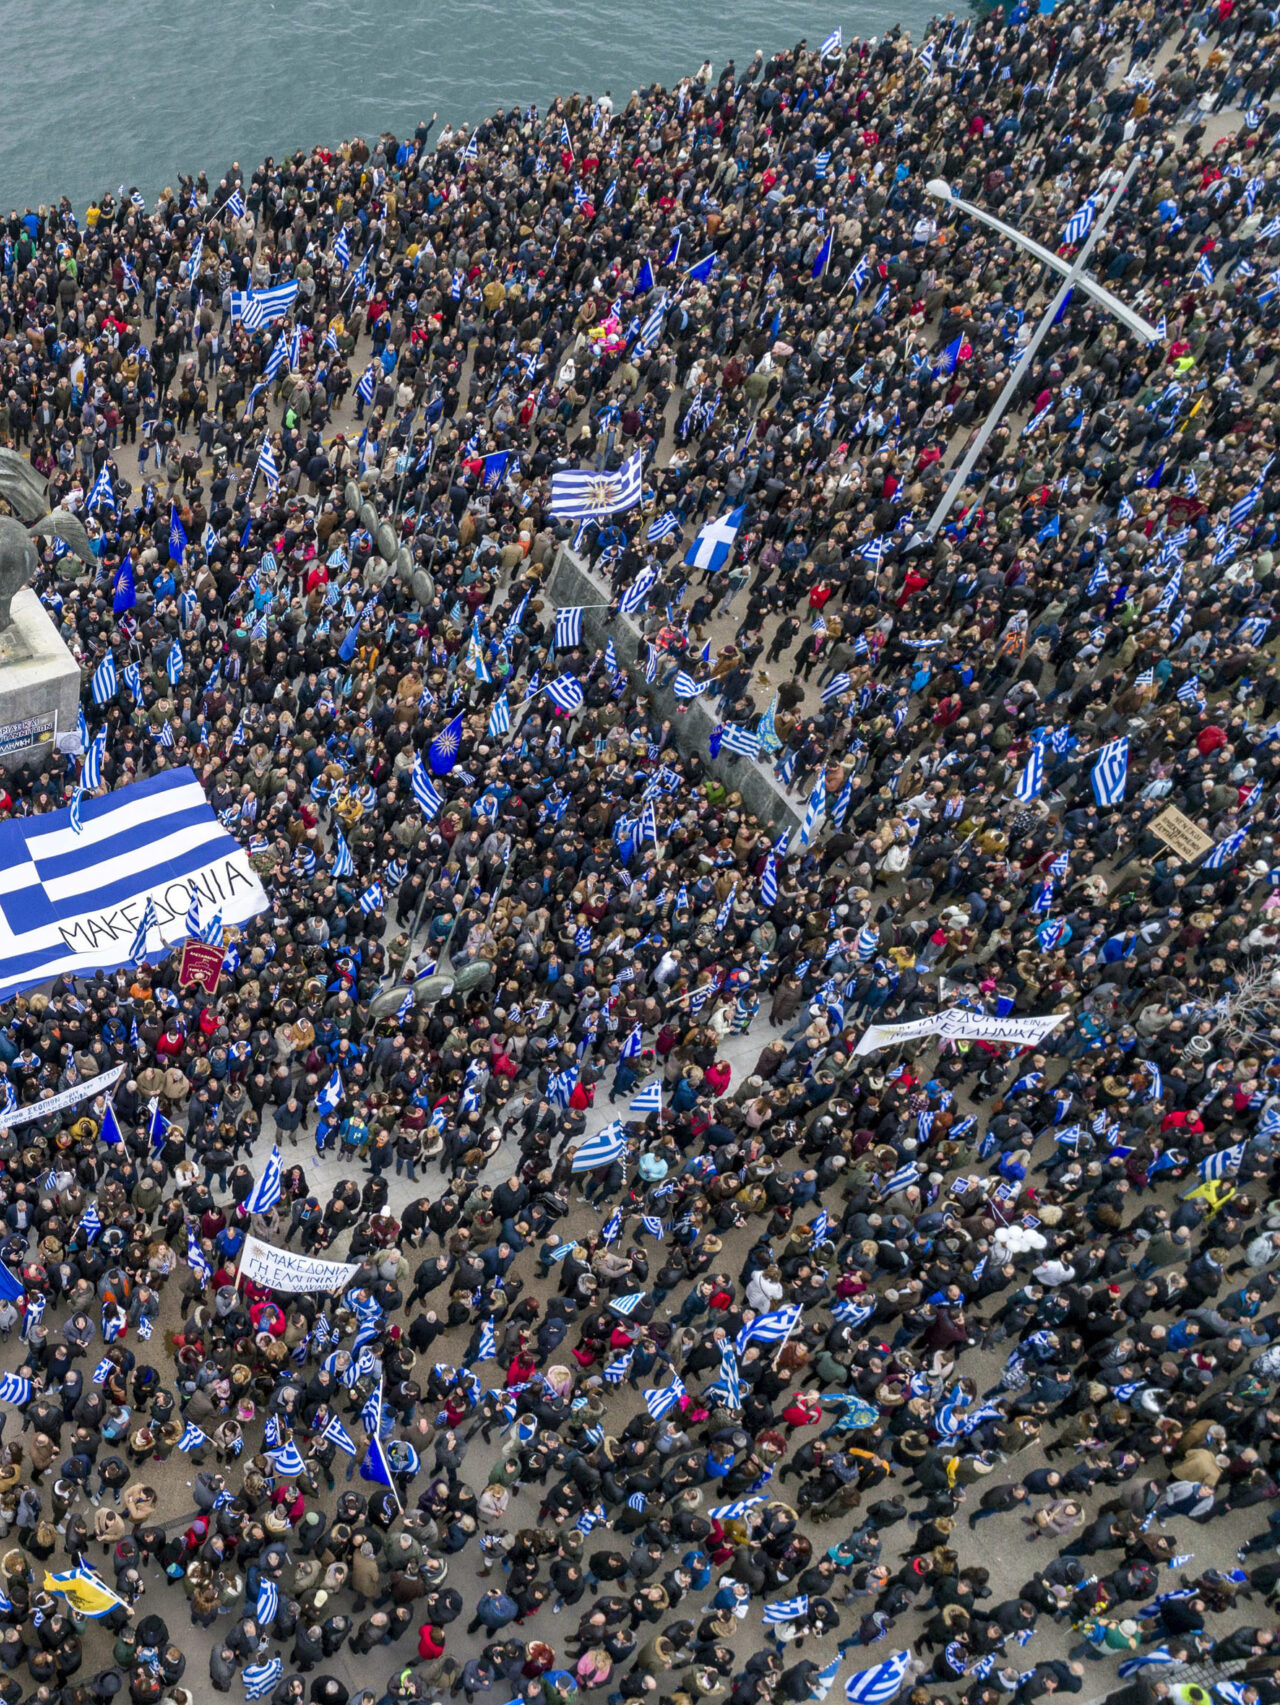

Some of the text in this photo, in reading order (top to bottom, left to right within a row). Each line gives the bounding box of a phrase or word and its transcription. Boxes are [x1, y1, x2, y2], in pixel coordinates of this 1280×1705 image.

[23, 716, 39, 729] ΚΑΙ
[59, 861, 253, 952] ΜΑΚΕΔΟΝΙΑ
[940, 1022, 1046, 1041] ΕΛΛΗΝΙΚΗ
[27, 1096, 61, 1115] ΣΚΟΠΙΩΝ
[249, 1258, 269, 1275] ΓΗ
[266, 1250, 349, 1276] ΜΑΚΕΔΟΝΙΑ
[252, 1271, 283, 1288] ΣΥΚΙΑ
